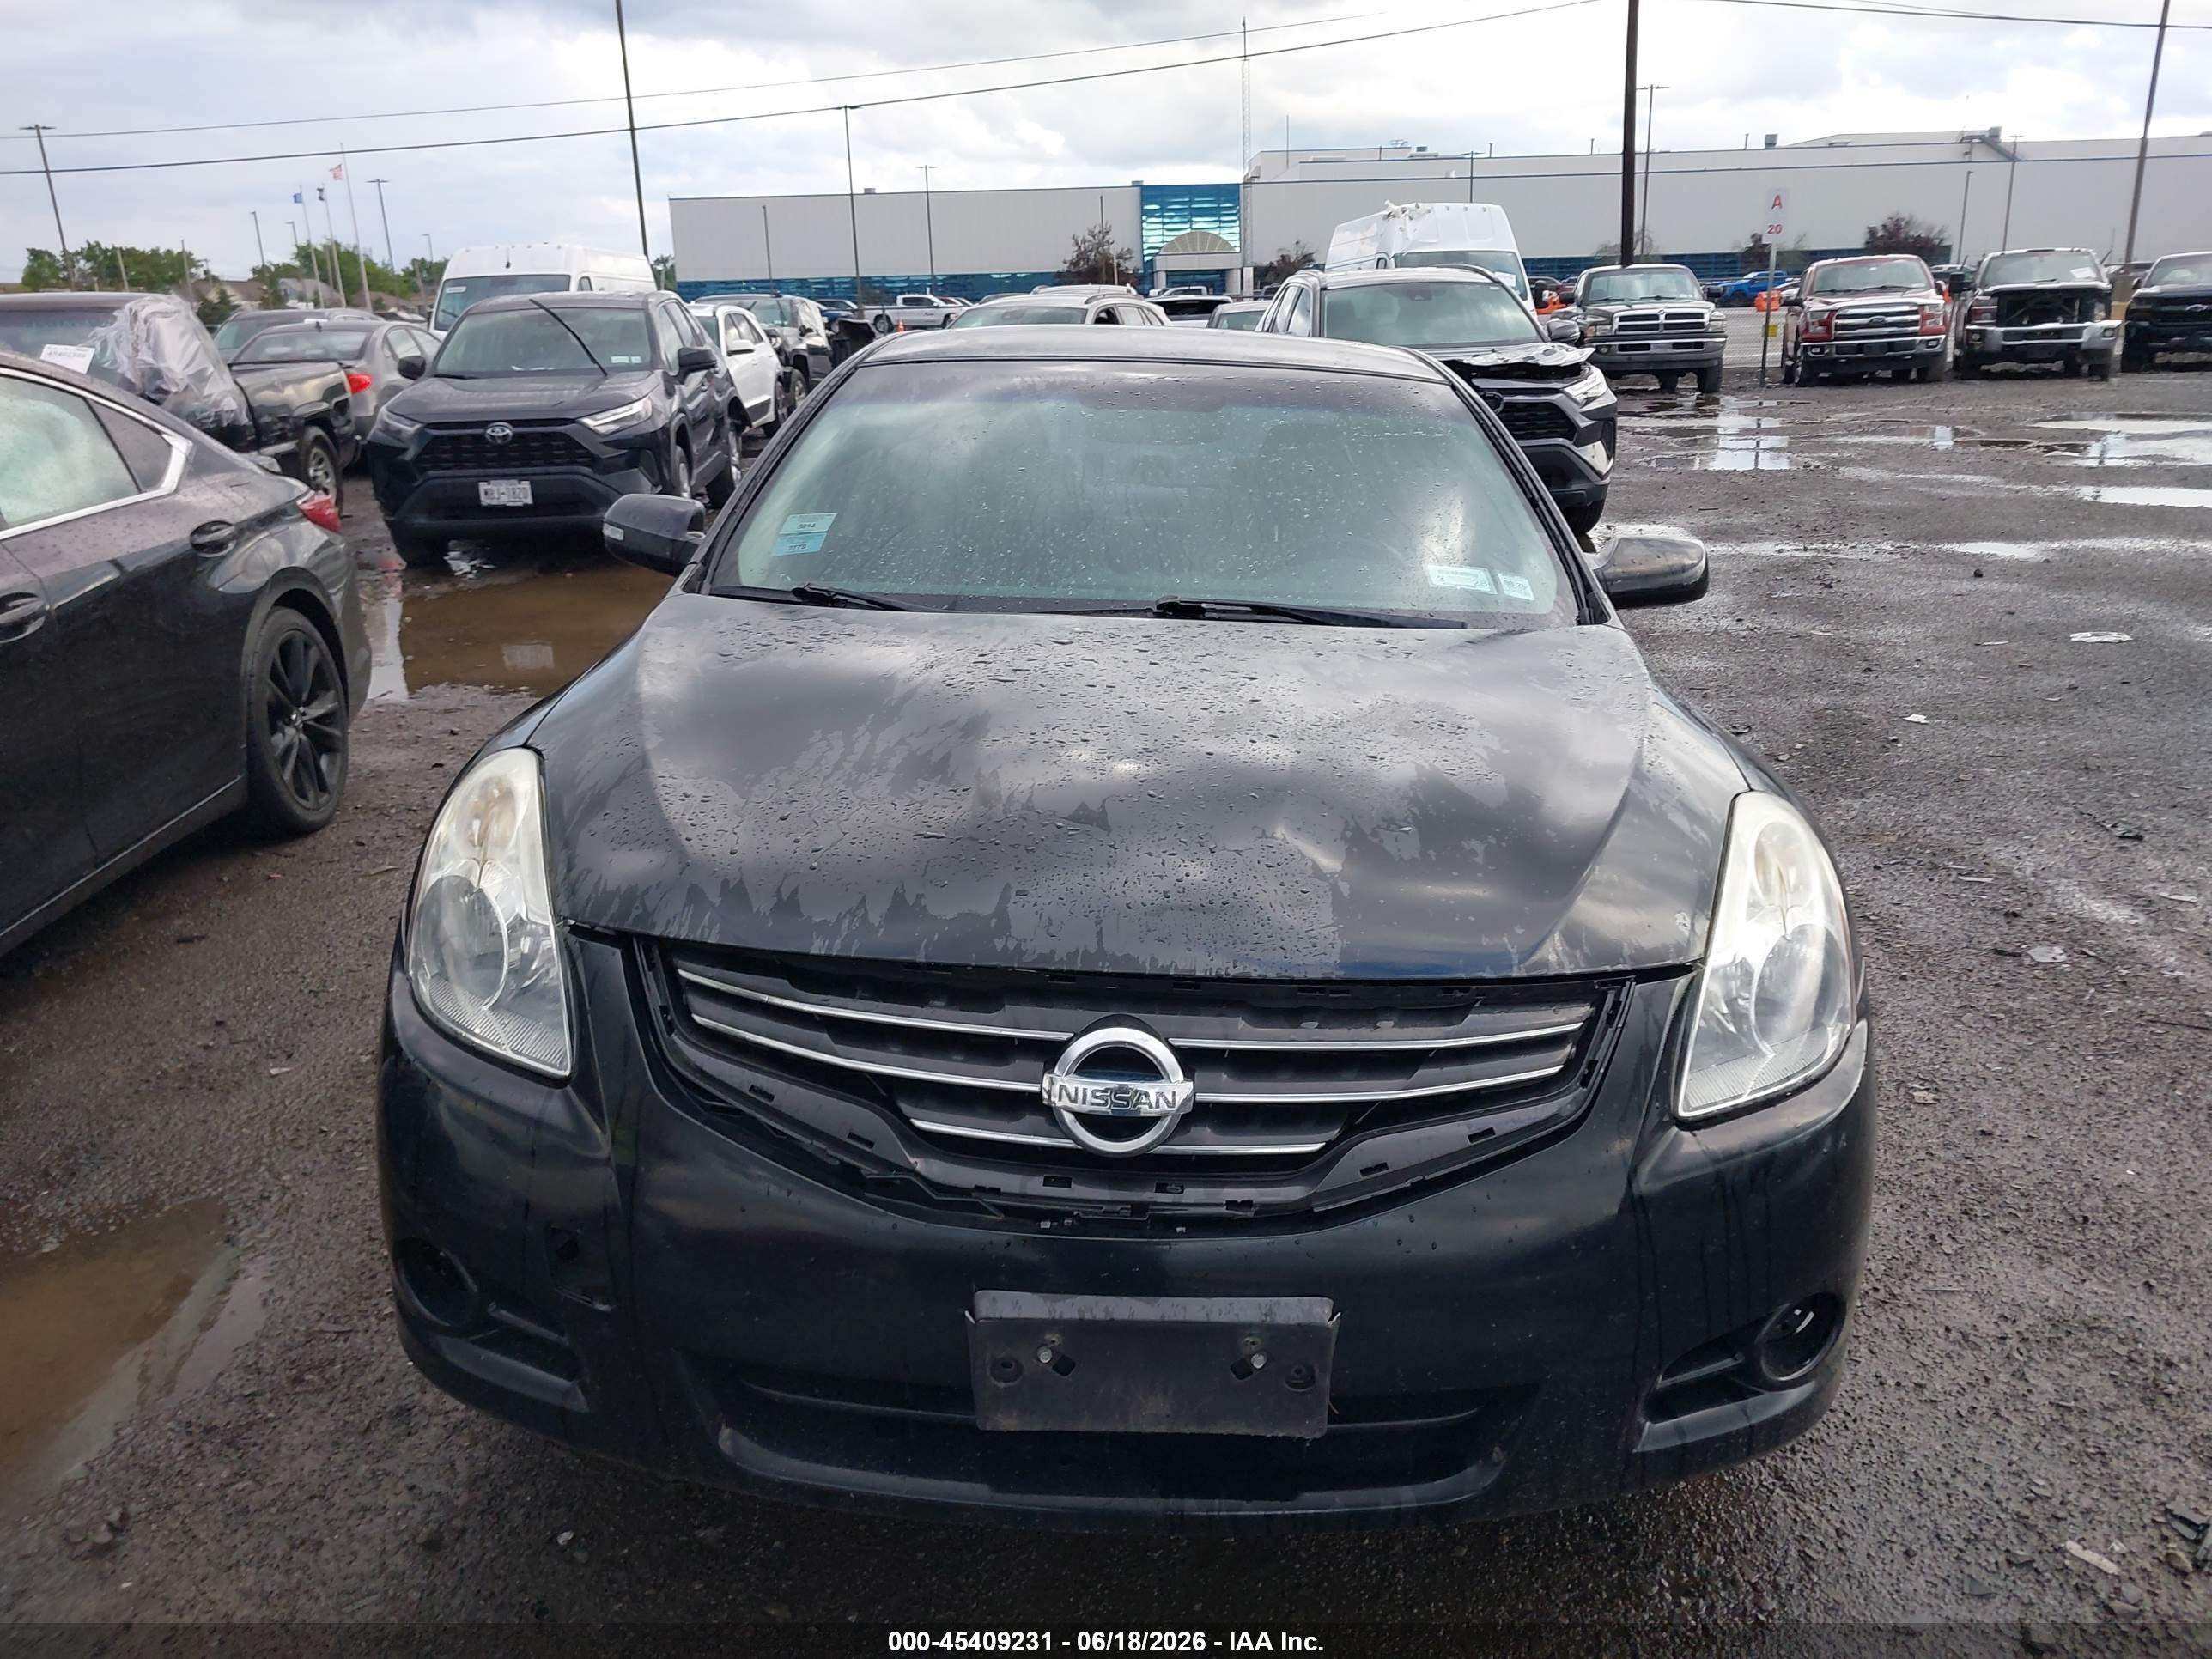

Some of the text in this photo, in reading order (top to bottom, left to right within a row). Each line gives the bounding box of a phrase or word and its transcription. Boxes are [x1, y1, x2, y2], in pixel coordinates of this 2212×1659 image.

[1771, 194, 1783, 210] A
[1767, 224, 1783, 234] 20
[1058, 1084, 1176, 1110] NISSAN
